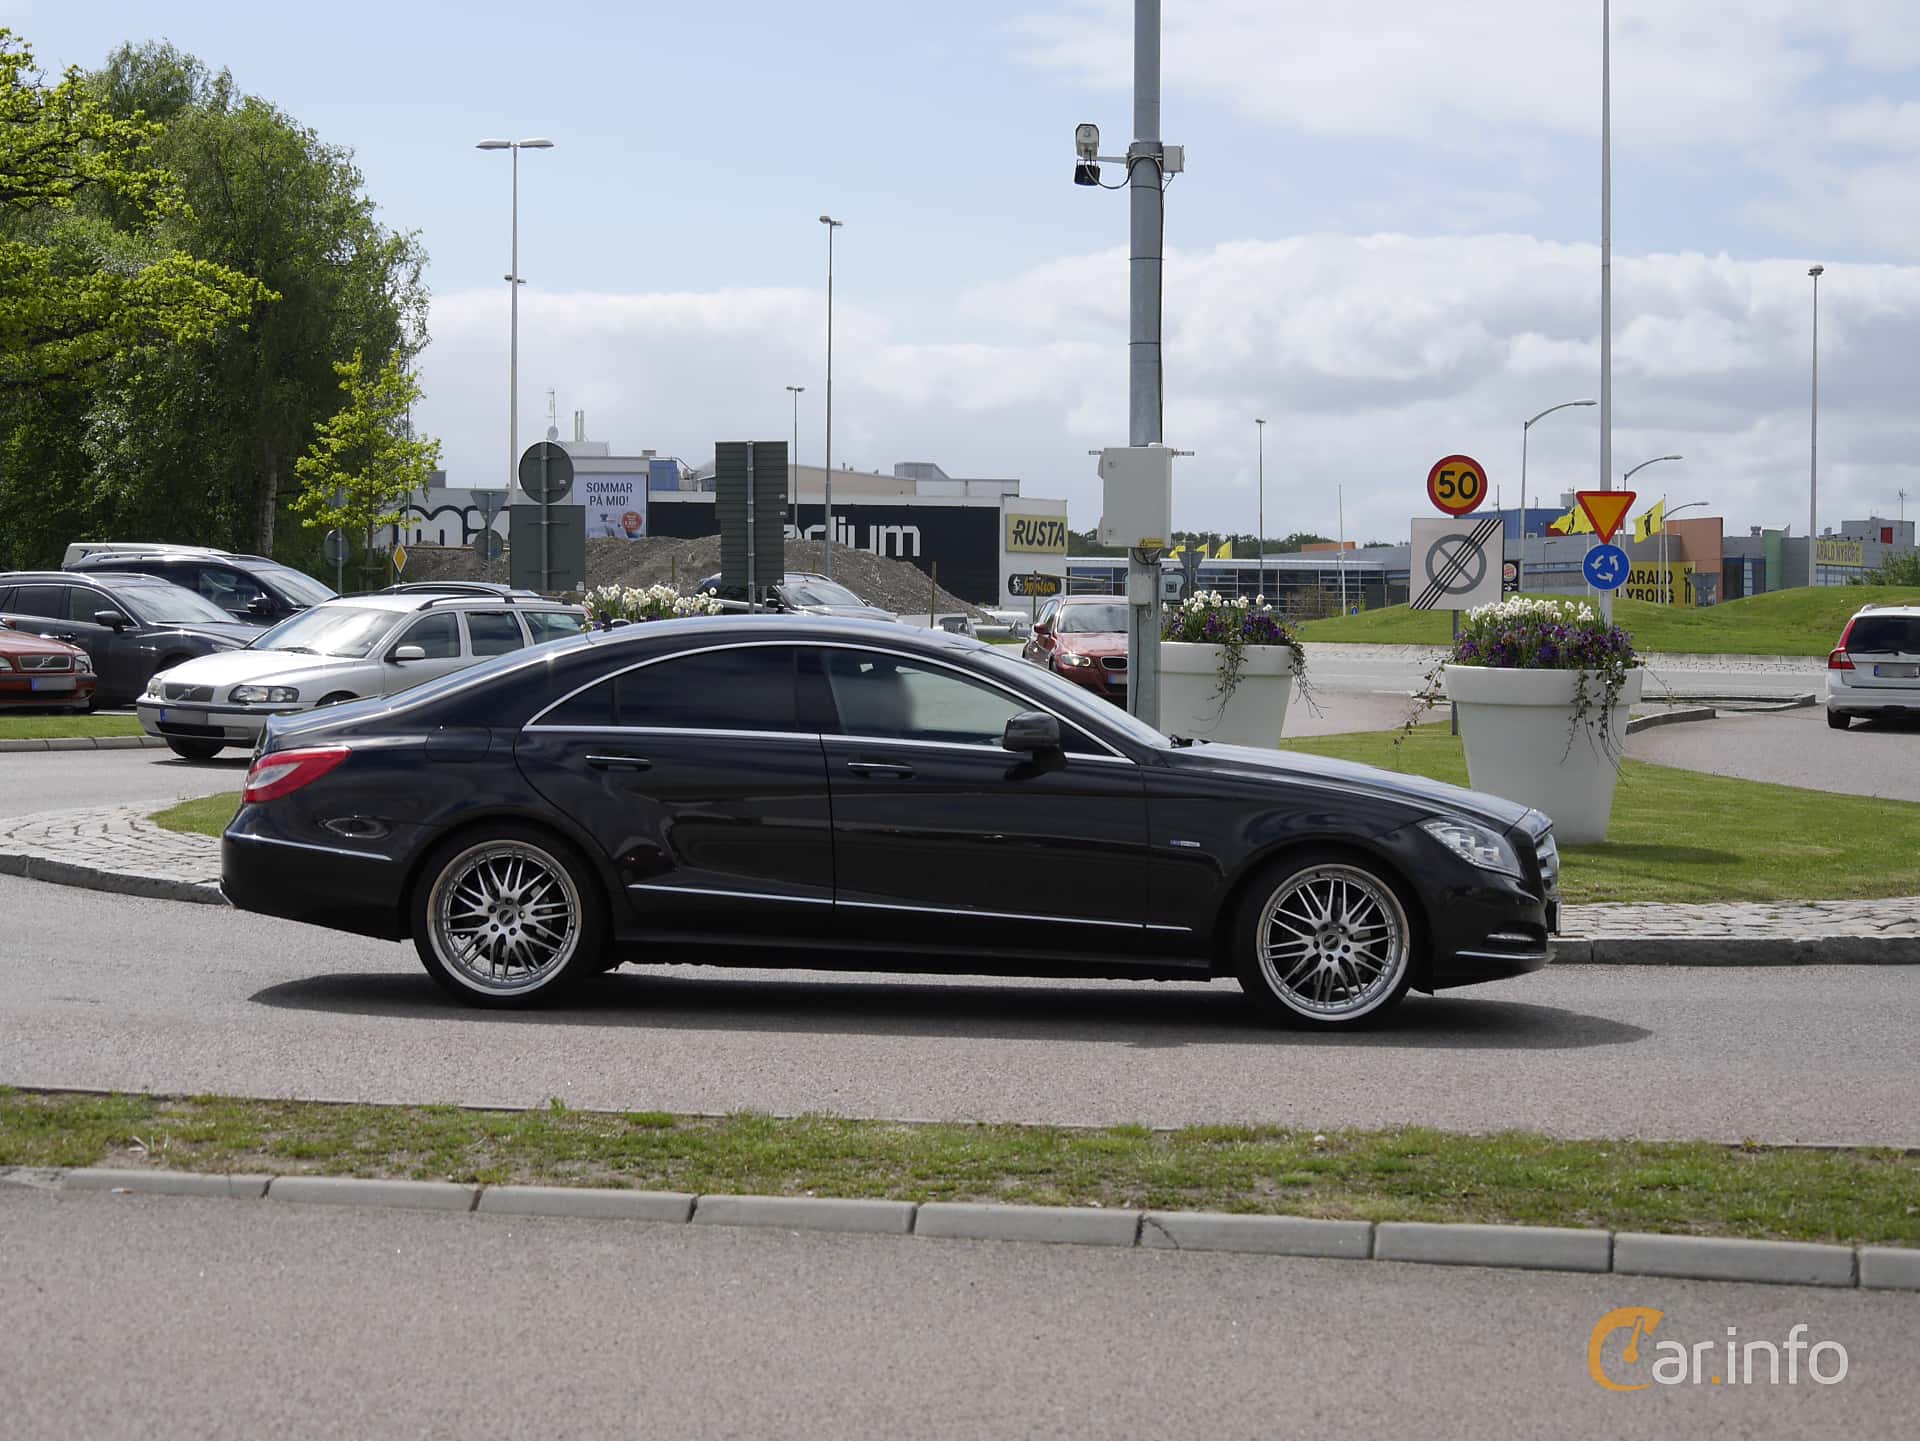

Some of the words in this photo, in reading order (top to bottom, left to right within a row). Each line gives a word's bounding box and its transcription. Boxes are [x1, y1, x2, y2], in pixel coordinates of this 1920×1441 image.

[586, 482, 633, 493] SOMMAR
[1438, 470, 1479, 500] 50
[589, 494, 603, 506] PÅ
[606, 495, 629, 506] MIO!
[1012, 519, 1065, 547] RUSTA
[1627, 569, 1674, 585] ARALD
